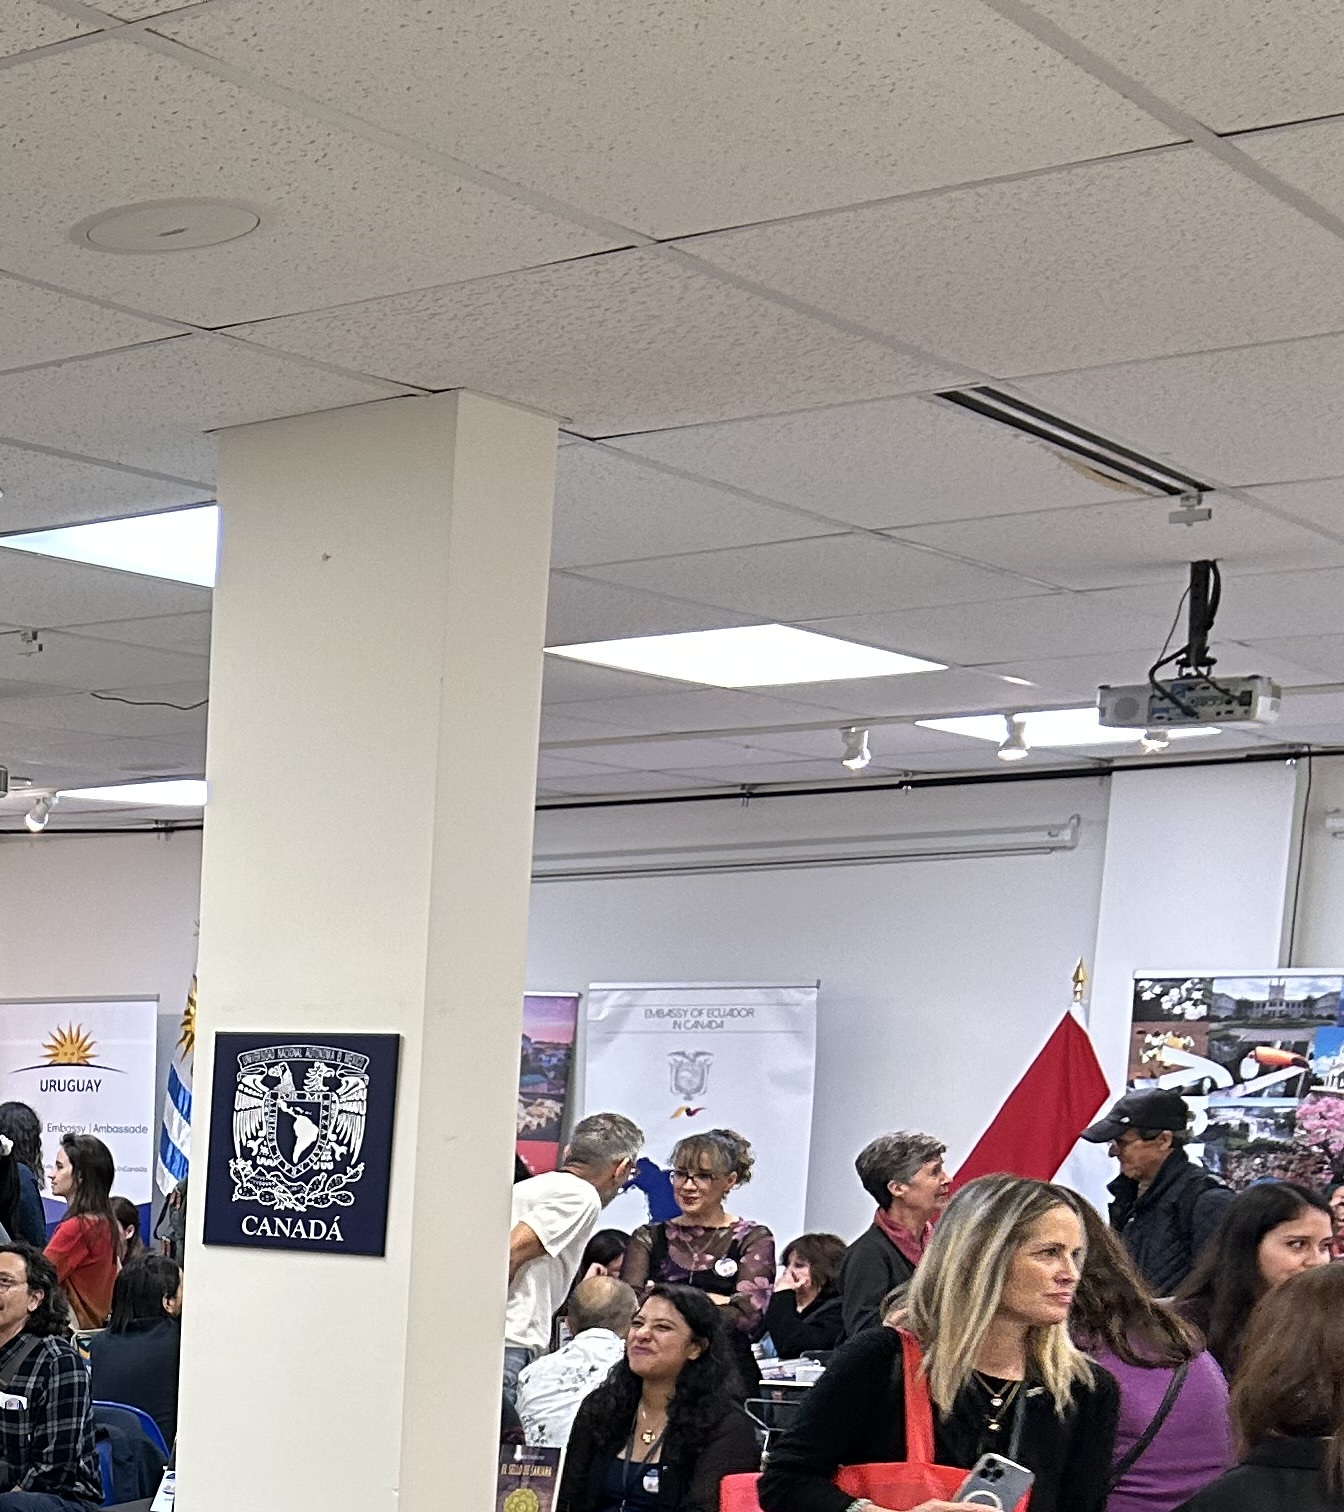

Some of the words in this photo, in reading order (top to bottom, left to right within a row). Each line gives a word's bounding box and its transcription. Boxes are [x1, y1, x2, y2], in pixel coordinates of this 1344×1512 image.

[644, 1008, 689, 1018] EMBASSY
[690, 1008, 705, 1018] OF
[706, 1007, 755, 1018] ECUADOR
[672, 1020, 683, 1029] IN
[683, 1020, 725, 1030] CANADA
[39, 1078, 102, 1093] URUGUAY
[46, 1122, 86, 1135] Embassy
[92, 1123, 148, 1134] Ambassade
[241, 1214, 345, 1242] CANADÁ
